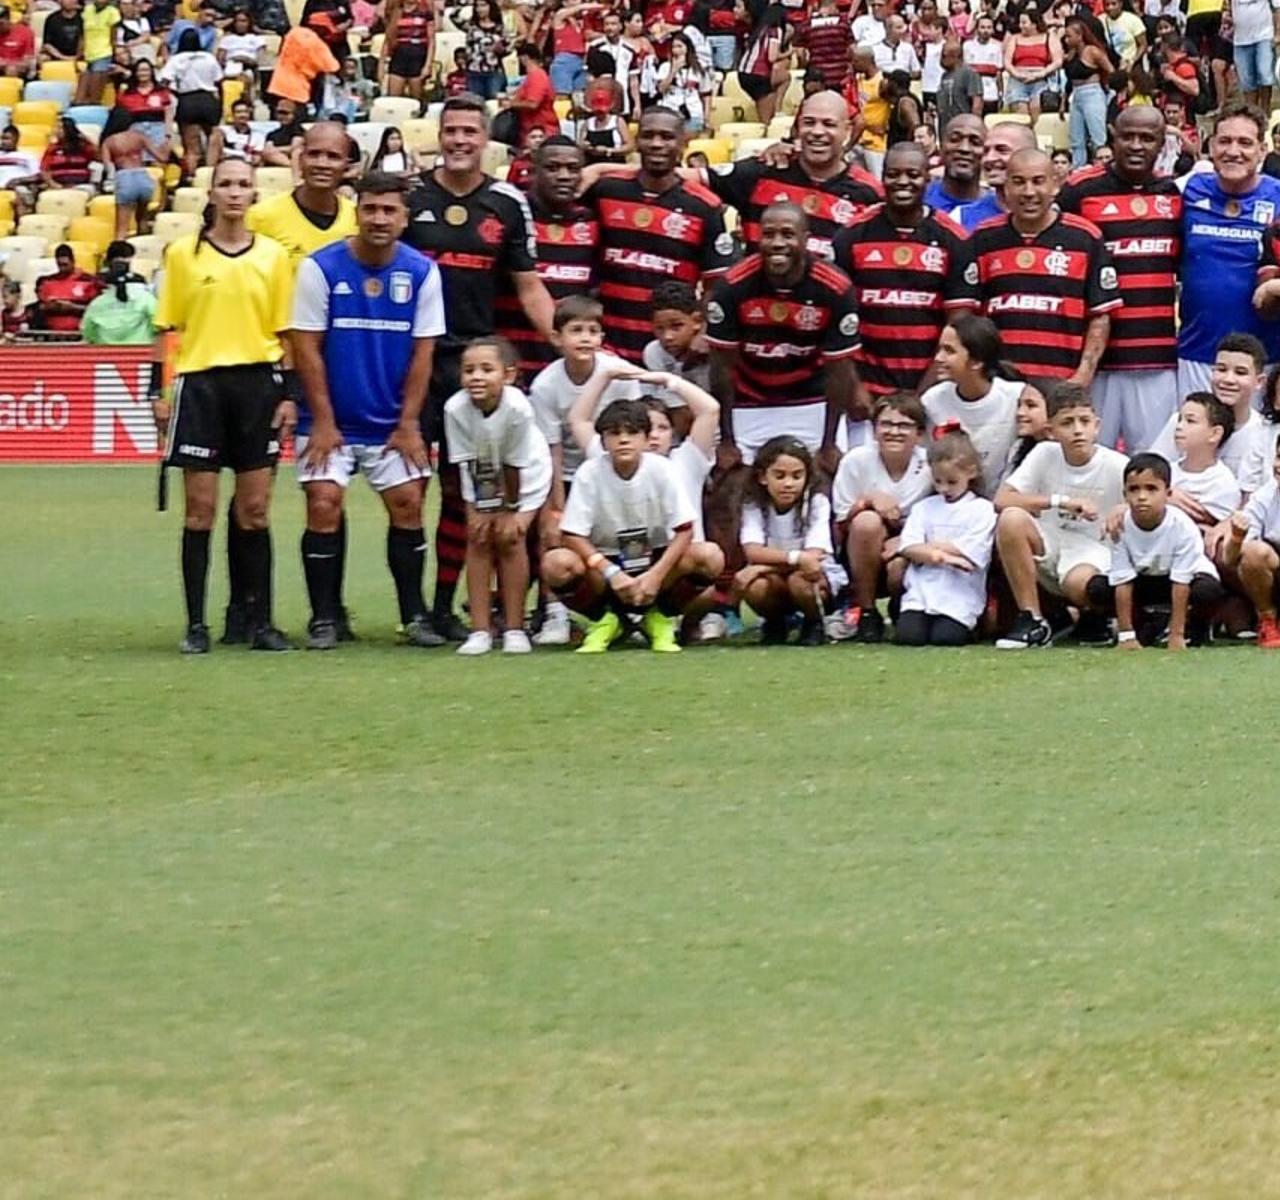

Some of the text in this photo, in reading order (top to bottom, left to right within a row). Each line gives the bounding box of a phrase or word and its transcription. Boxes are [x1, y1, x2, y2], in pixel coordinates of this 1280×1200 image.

[1191, 224, 1263, 241] NEXUSGUAR
[1104, 239, 1174, 255] FLABET
[605, 248, 680, 274] FLABET
[862, 288, 937, 306] FLABET
[988, 293, 1063, 313] FLABET
